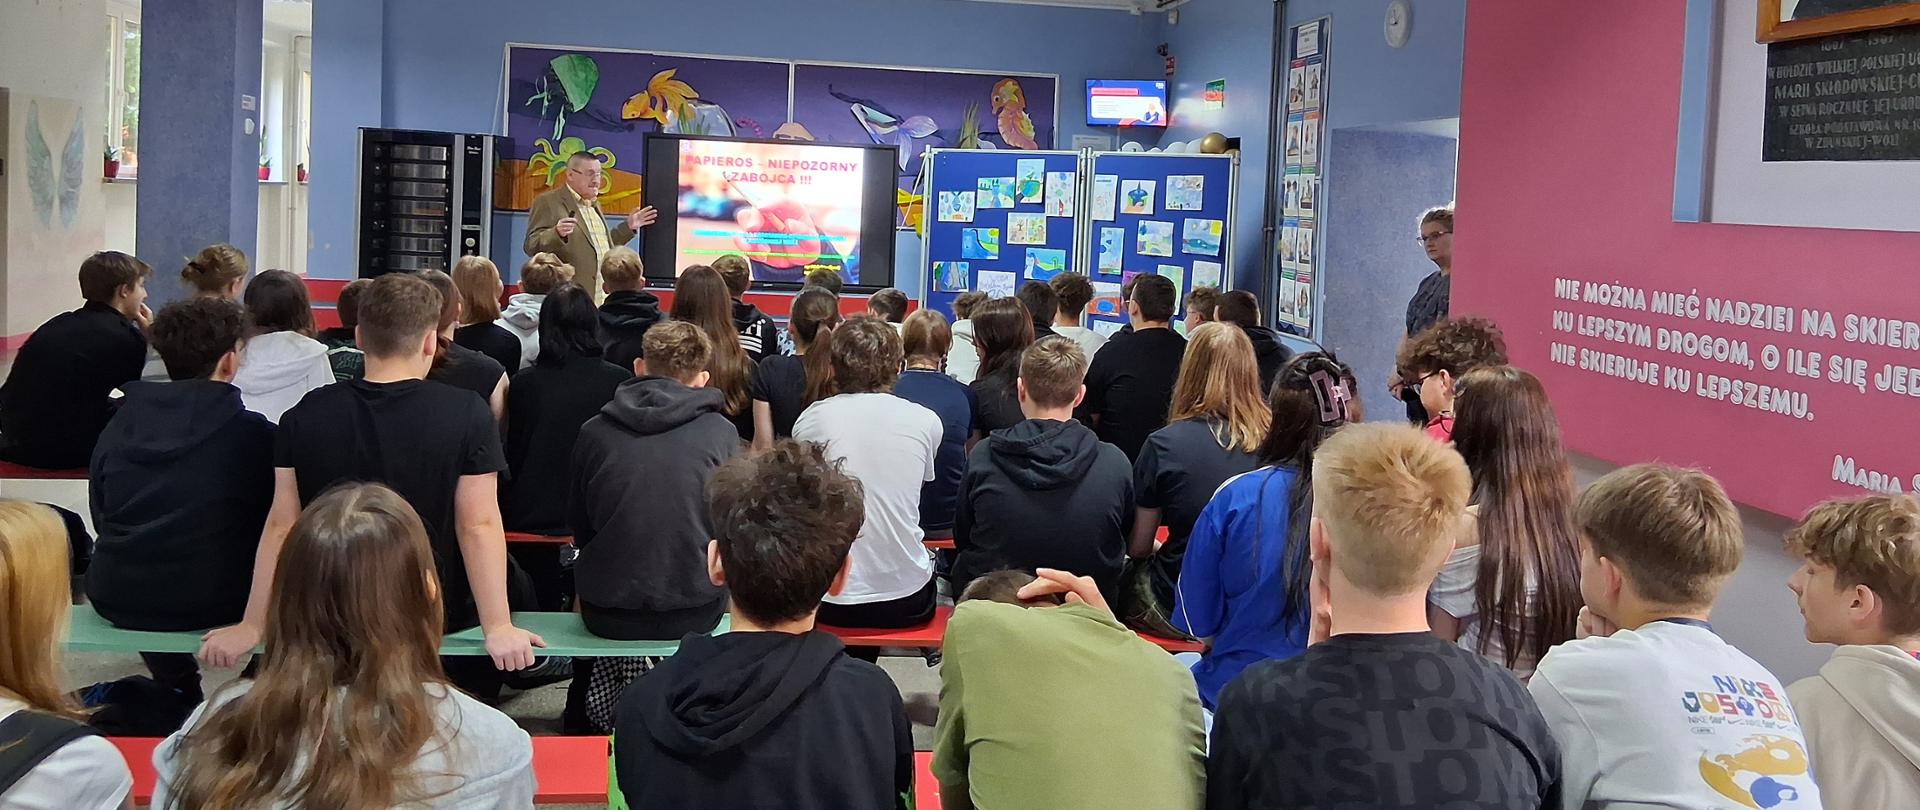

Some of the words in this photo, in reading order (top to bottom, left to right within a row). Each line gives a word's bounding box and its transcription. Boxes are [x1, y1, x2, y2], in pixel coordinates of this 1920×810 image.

[1774, 83, 1810, 99] MARII
[685, 154, 753, 168] PAPIEROS
[768, 159, 857, 172] NIEPOZORNY
[1554, 277, 1581, 301] NIE
[1583, 280, 1647, 311] MOŻNA
[1651, 288, 1700, 319] MIEĆ
[1705, 297, 1794, 333] NADZIEI
[1800, 308, 1837, 339] NA
[1843, 313, 1920, 351] SKIER
[1550, 341, 1577, 367] NIE
[1579, 347, 1659, 387] SKIERUJE
[1664, 364, 1691, 393] KU
[1696, 372, 1816, 422] LEPSZEMU.
[1552, 310, 1574, 333] KU
[1577, 313, 1652, 348] LEPSZYM
[1656, 327, 1754, 371] DROGOM,
[1760, 344, 1781, 371] O
[1786, 348, 1822, 379] ILE
[1828, 354, 1868, 394] SIĘ
